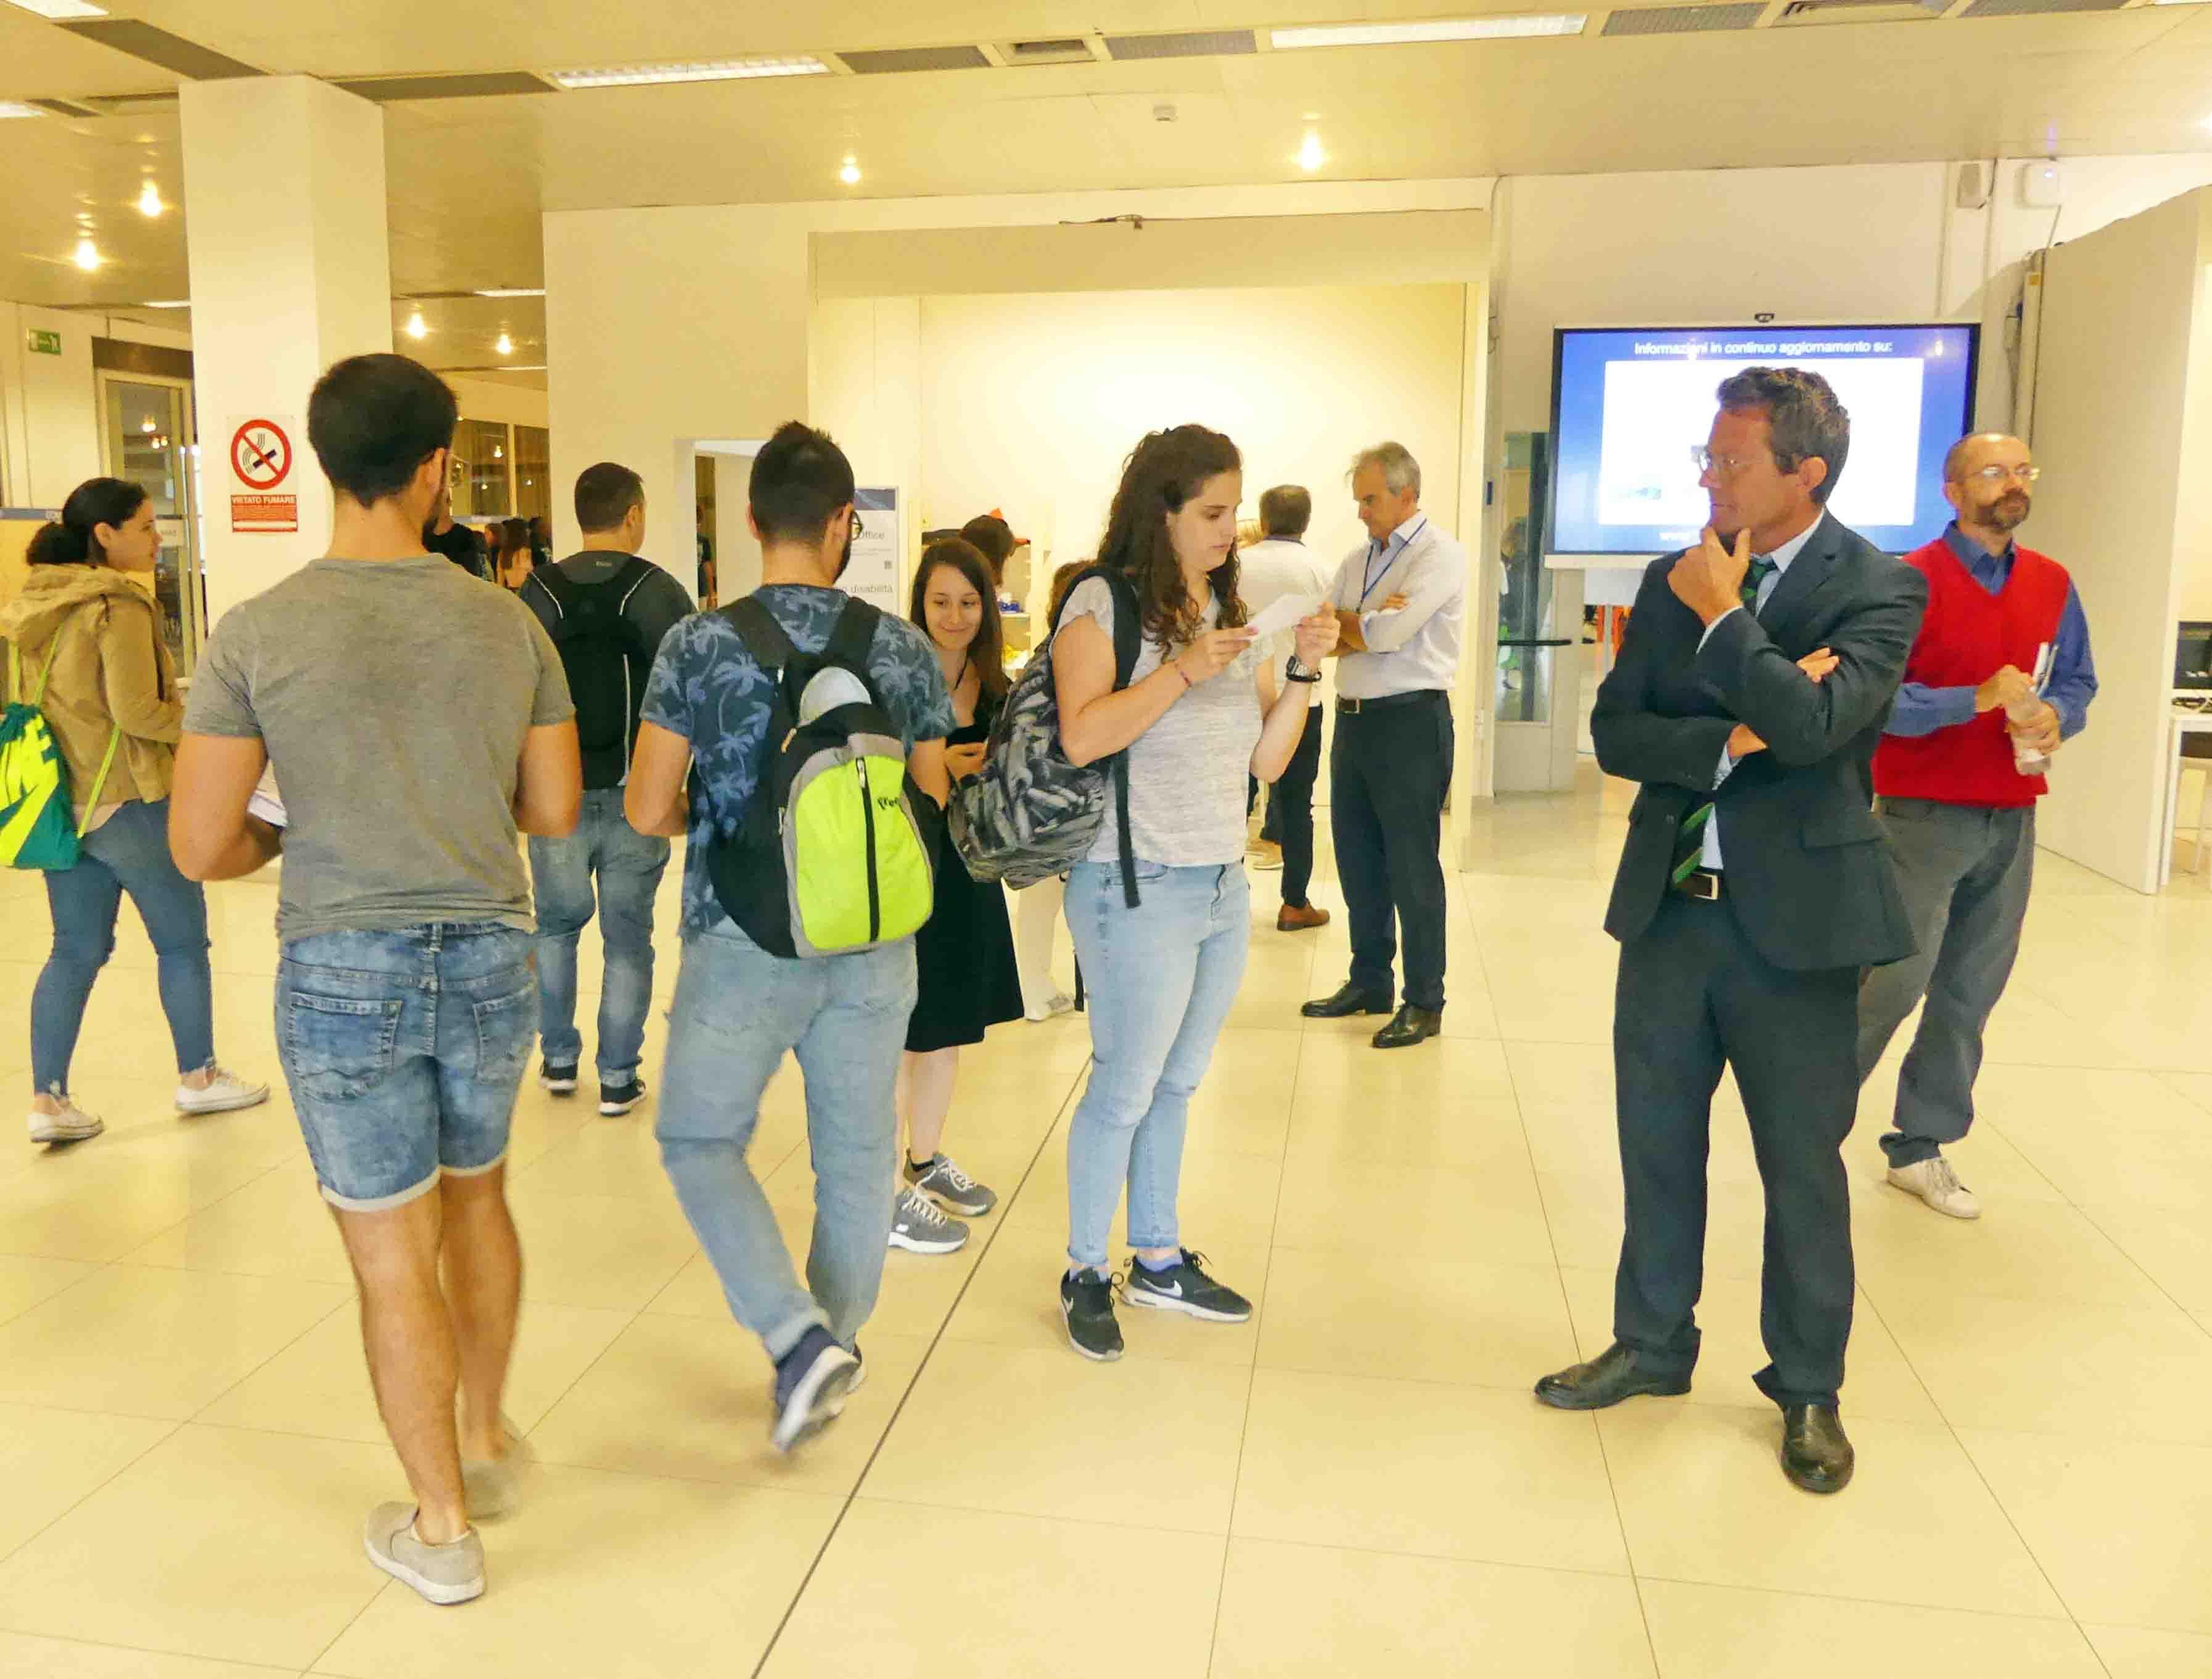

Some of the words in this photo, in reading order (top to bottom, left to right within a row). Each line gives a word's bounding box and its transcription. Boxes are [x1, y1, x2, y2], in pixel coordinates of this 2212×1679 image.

[1635, 342, 1708, 355] Informazini
[1710, 342, 1722, 354] in
[1724, 341, 1777, 354] continuo
[1778, 340, 1872, 356] aggiornamento
